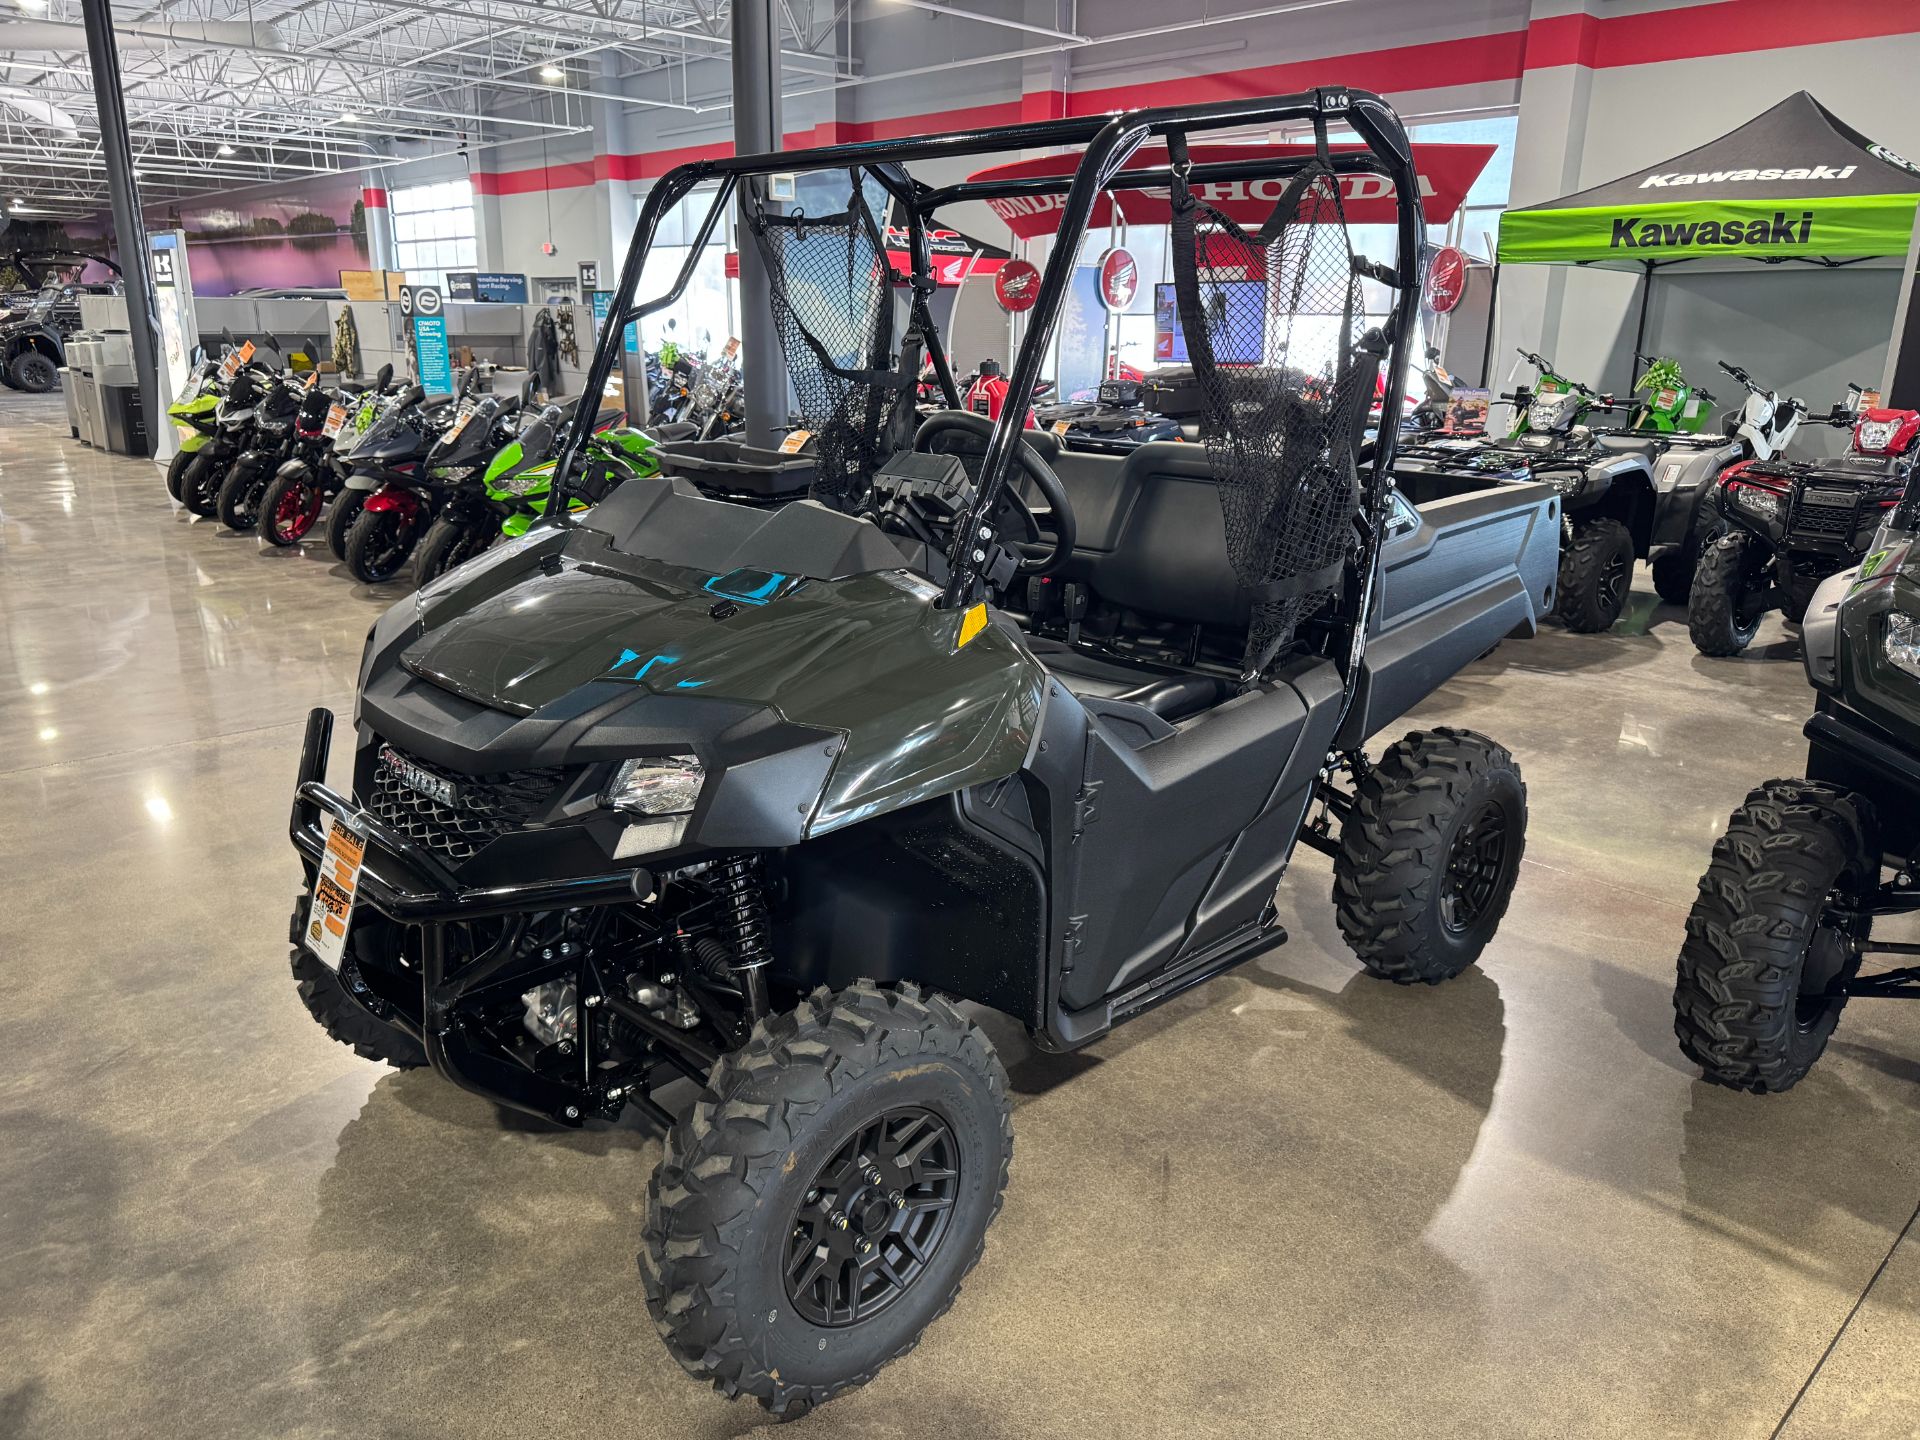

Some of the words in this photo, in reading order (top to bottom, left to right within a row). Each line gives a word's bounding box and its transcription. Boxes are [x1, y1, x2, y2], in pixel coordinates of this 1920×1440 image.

[1200, 174, 1438, 201] HONDA
[1638, 165, 1858, 189] Kawasaki
[1610, 211, 1814, 248] Kawasaki
[1806, 493, 1851, 505] HONDA
[378, 742, 456, 807] HONDA
[331, 821, 347, 839] FOR
[344, 832, 364, 851] SALE
